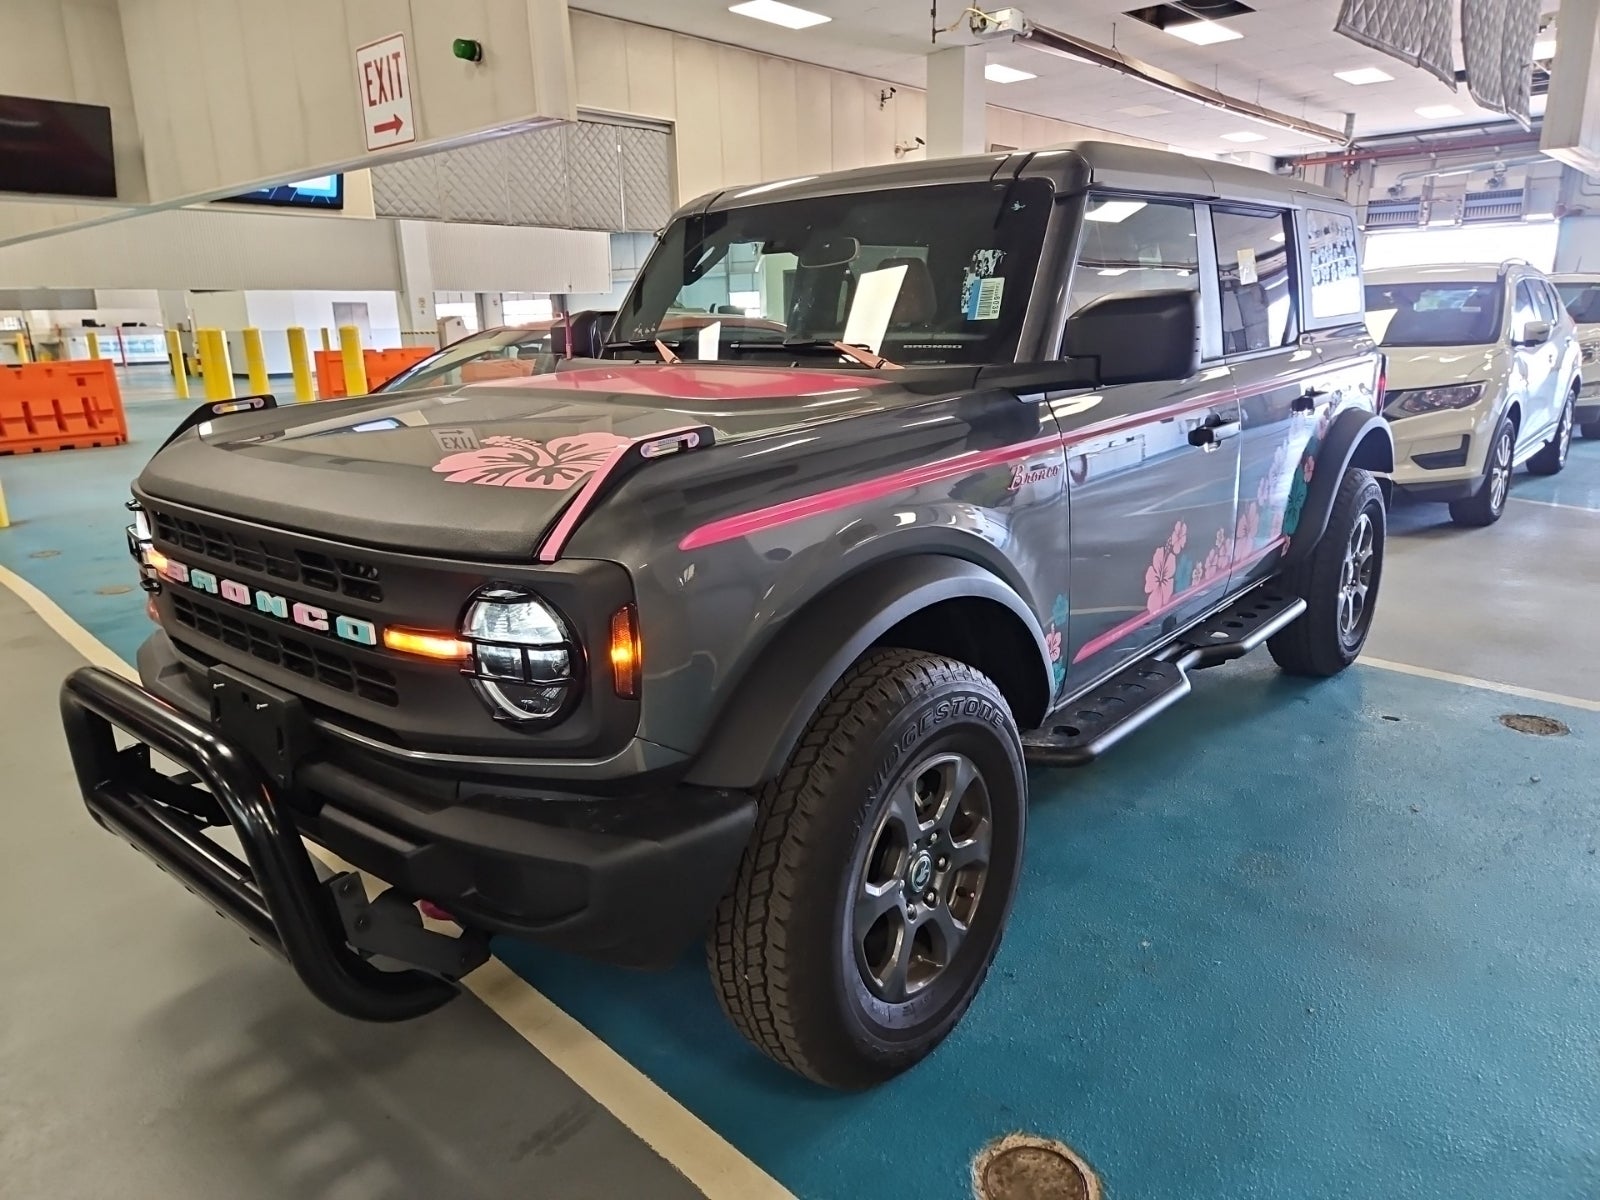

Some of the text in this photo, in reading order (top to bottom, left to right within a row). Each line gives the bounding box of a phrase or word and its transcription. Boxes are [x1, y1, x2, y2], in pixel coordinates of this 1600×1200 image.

[364, 51, 403, 107] EXIT
[1007, 464, 1060, 491] Bronco
[166, 558, 377, 646] BRONCO
